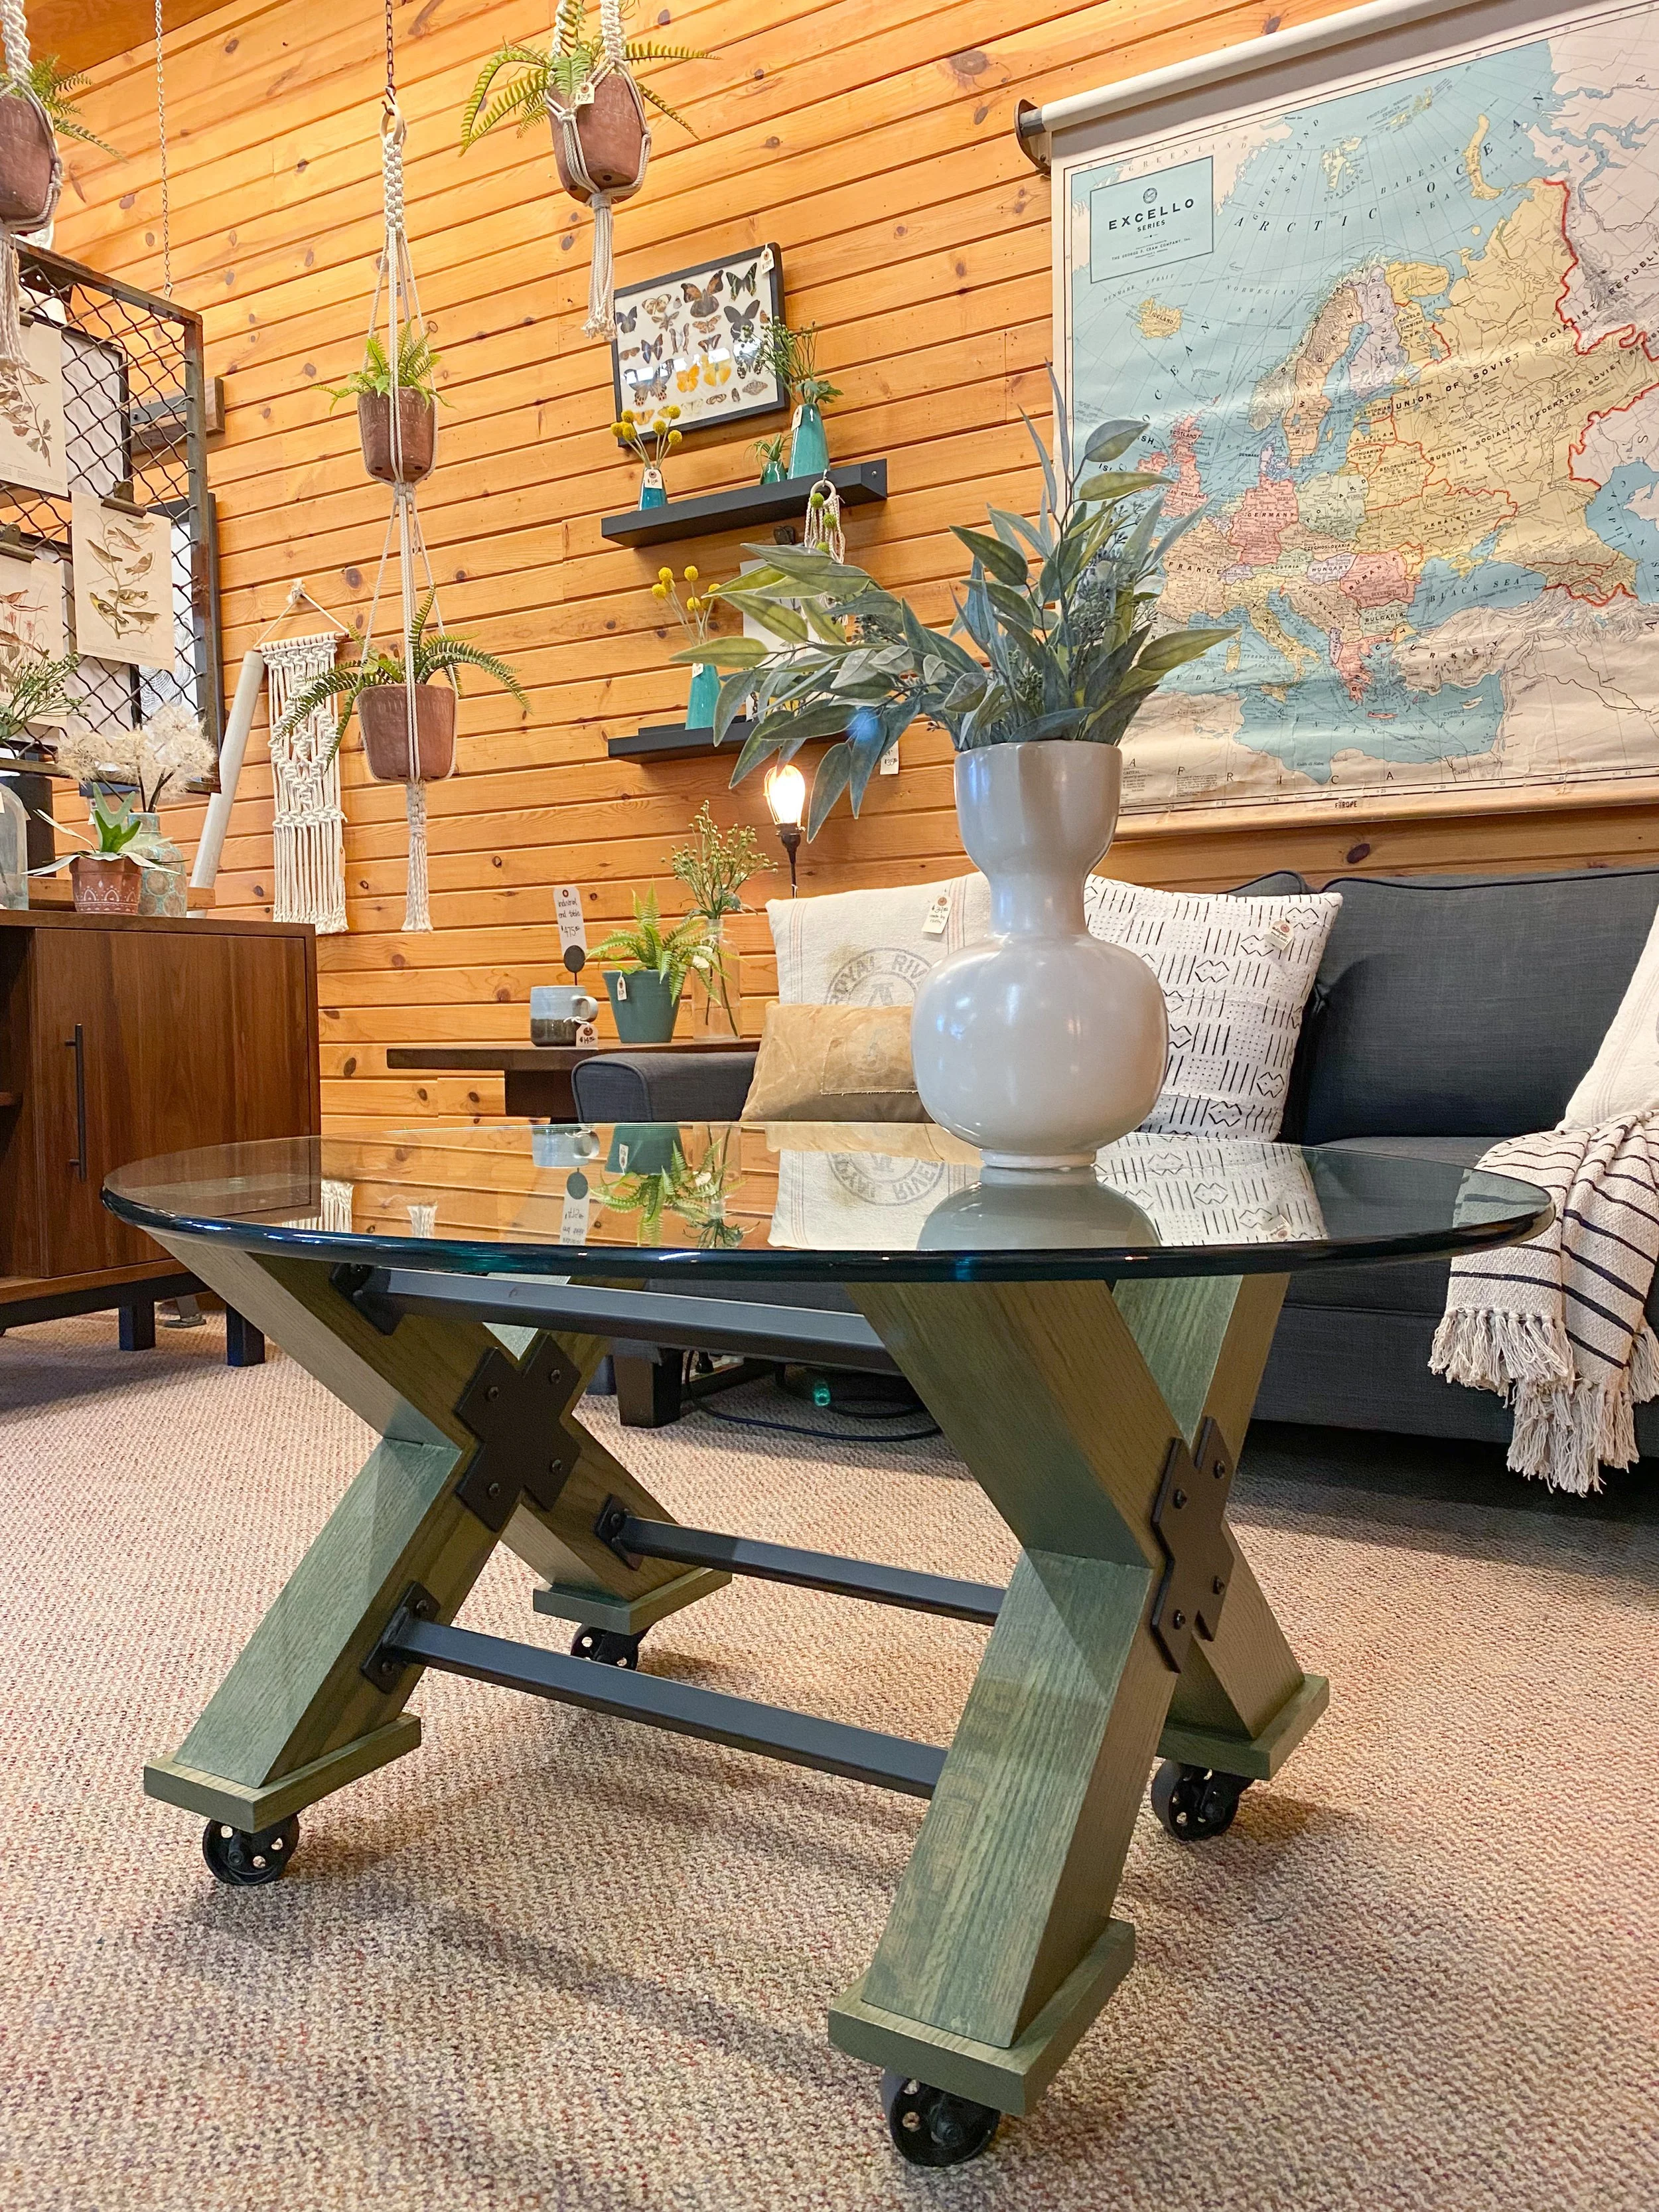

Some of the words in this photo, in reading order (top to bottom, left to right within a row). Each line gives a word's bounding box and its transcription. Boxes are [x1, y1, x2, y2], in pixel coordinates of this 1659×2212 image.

[1129, 142, 1247, 172] GREENLAND
[1234, 208, 1378, 233] ARCTIC
[1427, 92, 1544, 194] OCEAN
[1253, 119, 1319, 221] GREENLAND
[1285, 162, 1306, 194] SEA
[1380, 147, 1460, 194] BARENTS
[1109, 198, 1194, 230] EXCELLO
[1415, 193, 1450, 216] SEA
[1137, 219, 1166, 232] SERIES
[1104, 285, 1135, 303] DENMARK
[1146, 273, 1175, 285] STRAIT
[1226, 285, 1295, 295] NORWEGIAN
[1152, 312, 1174, 325] ICELAND
[1400, 319, 1423, 331] FINNISH
[1396, 392, 1432, 410] UNION
[1445, 380, 1460, 392] OF
[1473, 352, 1520, 380] SOVIET
[1535, 303, 1596, 347] SOCIALIST
[1364, 405, 1392, 415] ESTONIAN
[1430, 445, 1468, 462] RUSSIAN
[1476, 421, 1521, 445] SOCIALIST
[1530, 388, 1581, 419] FEDERATED
[1588, 360, 1621, 386] SOVIET
[1350, 432, 1394, 443] LATVIAN
[1350, 448, 1383, 458] LITHUANIAN
[1380, 460, 1417, 473] BELORUSSIAN
[1305, 479, 1366, 523] POLAND
[1424, 509, 1481, 530] UKRAINIAN
[1304, 543, 1351, 552] CZECHOSLOVAKIA
[1169, 561, 1222, 575] FRANCE
[1429, 584, 1479, 603] BLACK
[1493, 578, 1520, 589] SEA
[1298, 585, 1346, 630] YUGOSLAVIA
[1365, 612, 1404, 623] BULGARIA
[1238, 592, 1295, 653] ITALY
[1400, 628, 1499, 658] TURKEY
